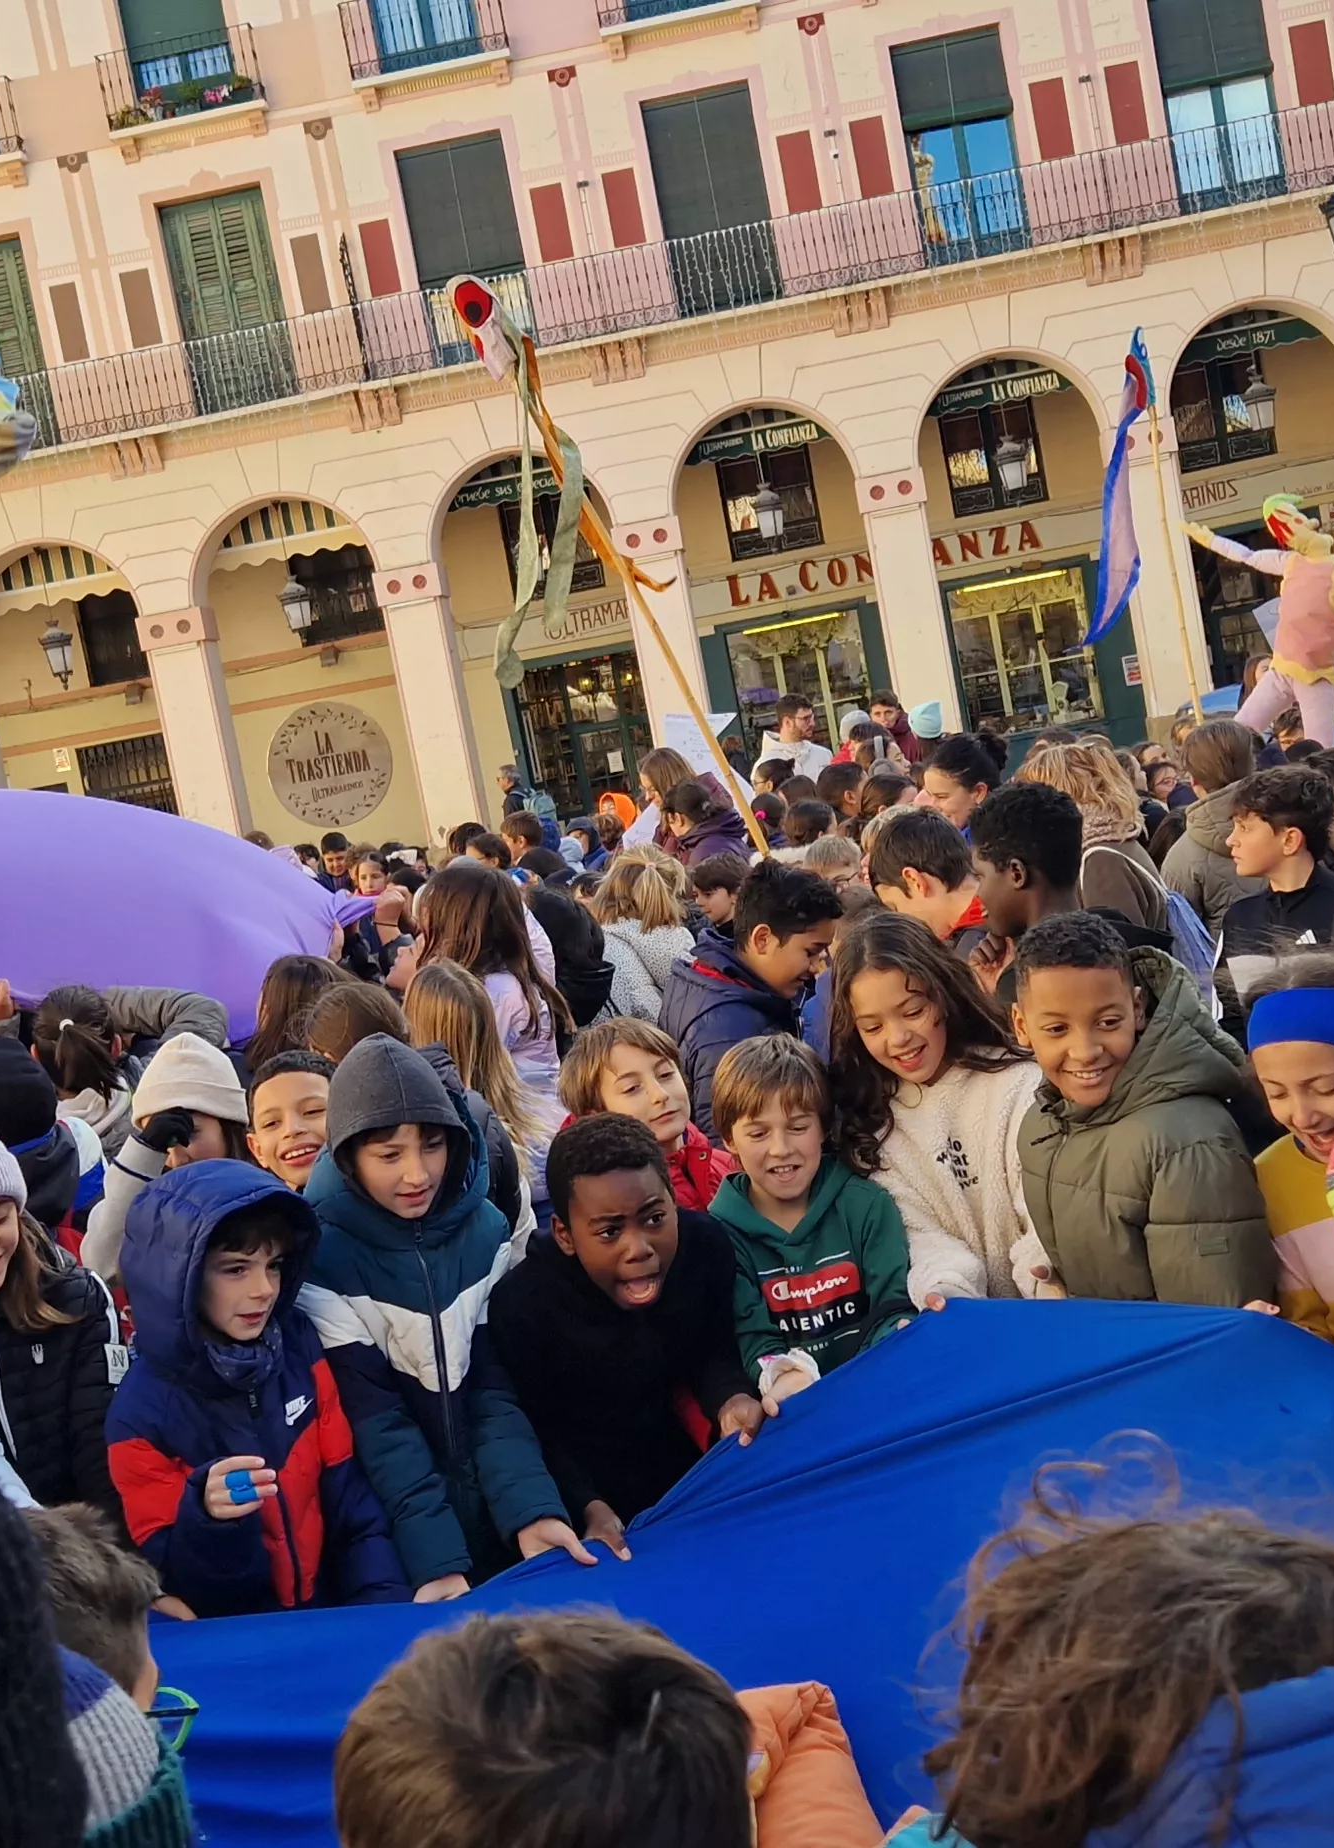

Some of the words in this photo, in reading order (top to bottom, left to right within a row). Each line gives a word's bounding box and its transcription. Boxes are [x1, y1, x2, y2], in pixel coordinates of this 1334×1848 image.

[1216, 334, 1247, 351] desde
[1252, 329, 1276, 344] 1871
[991, 382, 1006, 402] LA
[1007, 372, 1060, 398] CONFIANZA
[750, 432, 765, 451] LA
[766, 423, 819, 448] CONFIANZA
[495, 485, 513, 497] sus
[726, 571, 782, 608] LA
[314, 730, 335, 756] LA
[285, 749, 372, 784] TRASTIENDA
